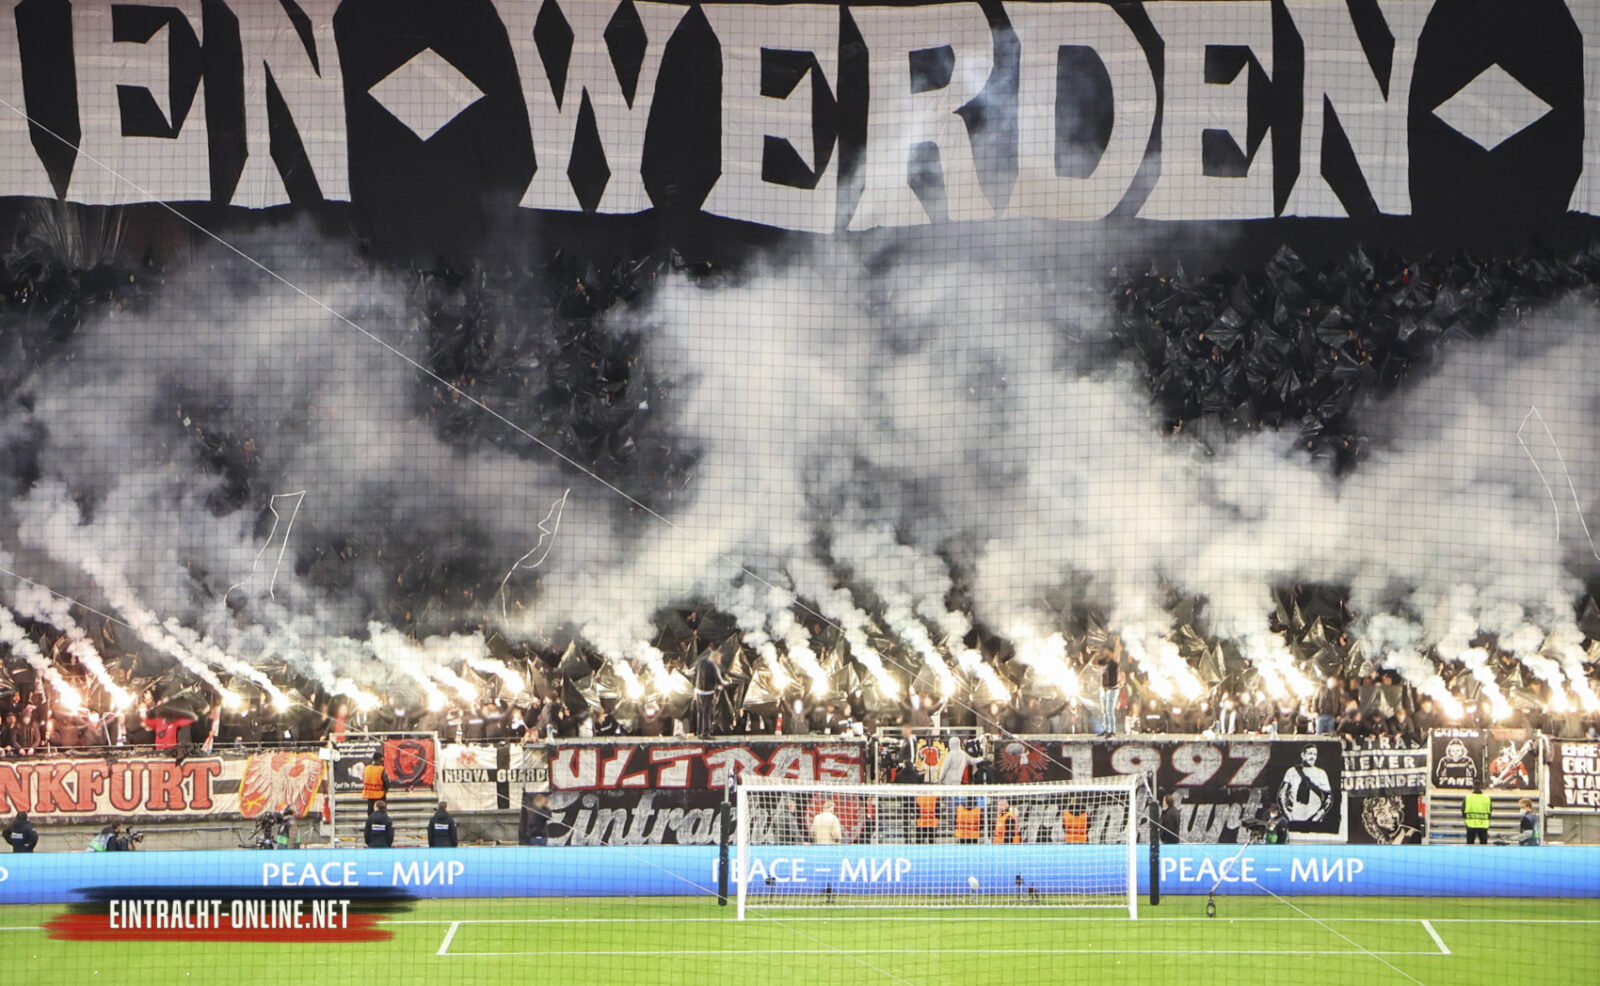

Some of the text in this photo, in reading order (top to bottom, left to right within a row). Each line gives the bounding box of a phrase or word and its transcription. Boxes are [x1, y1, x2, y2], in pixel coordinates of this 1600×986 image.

[0, 0, 352, 208] EN
[490, 0, 1438, 235] WERDEN
[550, 745, 866, 791] ULTRAS
[1061, 743, 1271, 787] 1997
[1344, 755, 1416, 770] NEVER
[443, 769, 490, 783] NUOVA
[262, 862, 359, 886] PEACE
[392, 861, 465, 885] МИР
[839, 858, 912, 883] МИР
[1160, 857, 1257, 882] PEACE
[1290, 858, 1364, 883] МИР
